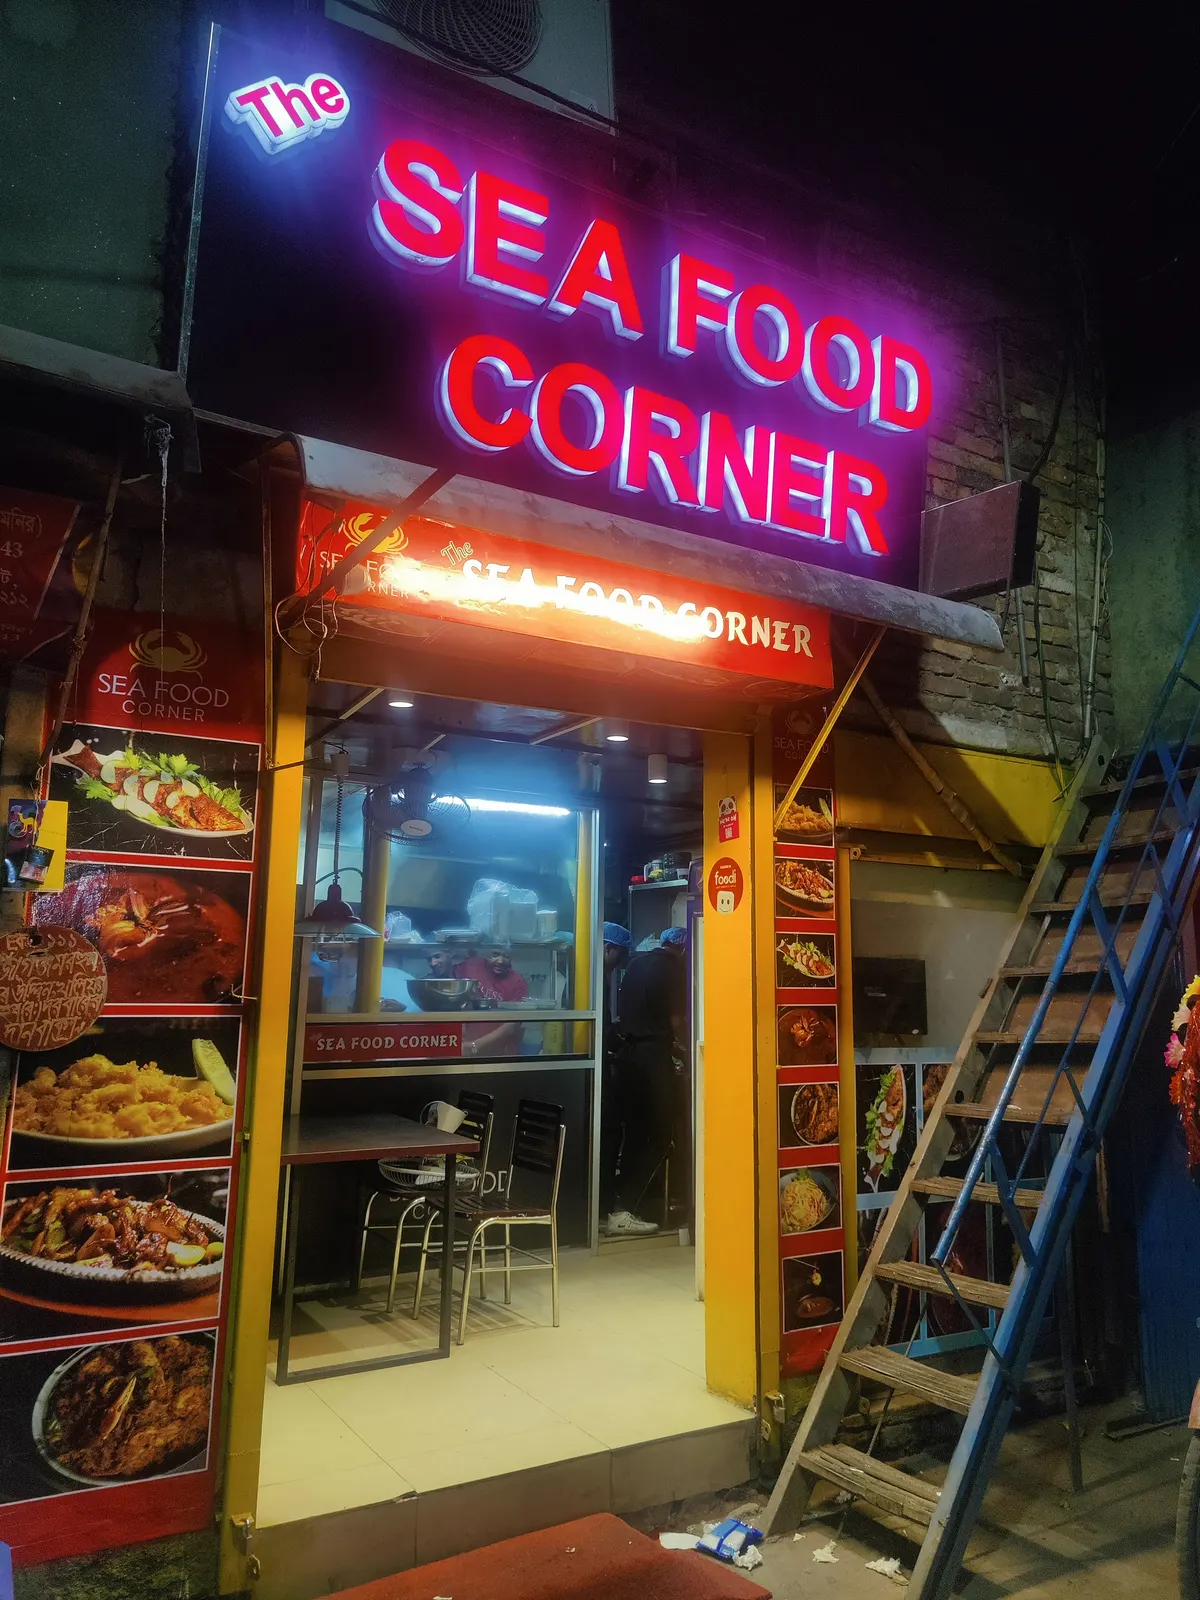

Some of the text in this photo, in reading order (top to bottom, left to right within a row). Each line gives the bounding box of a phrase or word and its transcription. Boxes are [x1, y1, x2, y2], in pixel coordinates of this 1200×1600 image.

[233, 77, 346, 140] The
[371, 139, 932, 431] SEA FOOD
[440, 334, 889, 556] CORNER
[441, 540, 474, 566] The
[367, 581, 410, 599] RNER
[461, 558, 814, 658] SEA FOOD CORNER
[97, 673, 230, 708] SEA FOOD
[122, 699, 206, 722] CORNER
[774, 736, 829, 754] SEA FOD
[714, 868, 738, 886] foodi
[316, 1038, 346, 1051] SEA
[351, 1036, 395, 1050] FOOD
[399, 1034, 458, 1048] CORNER
